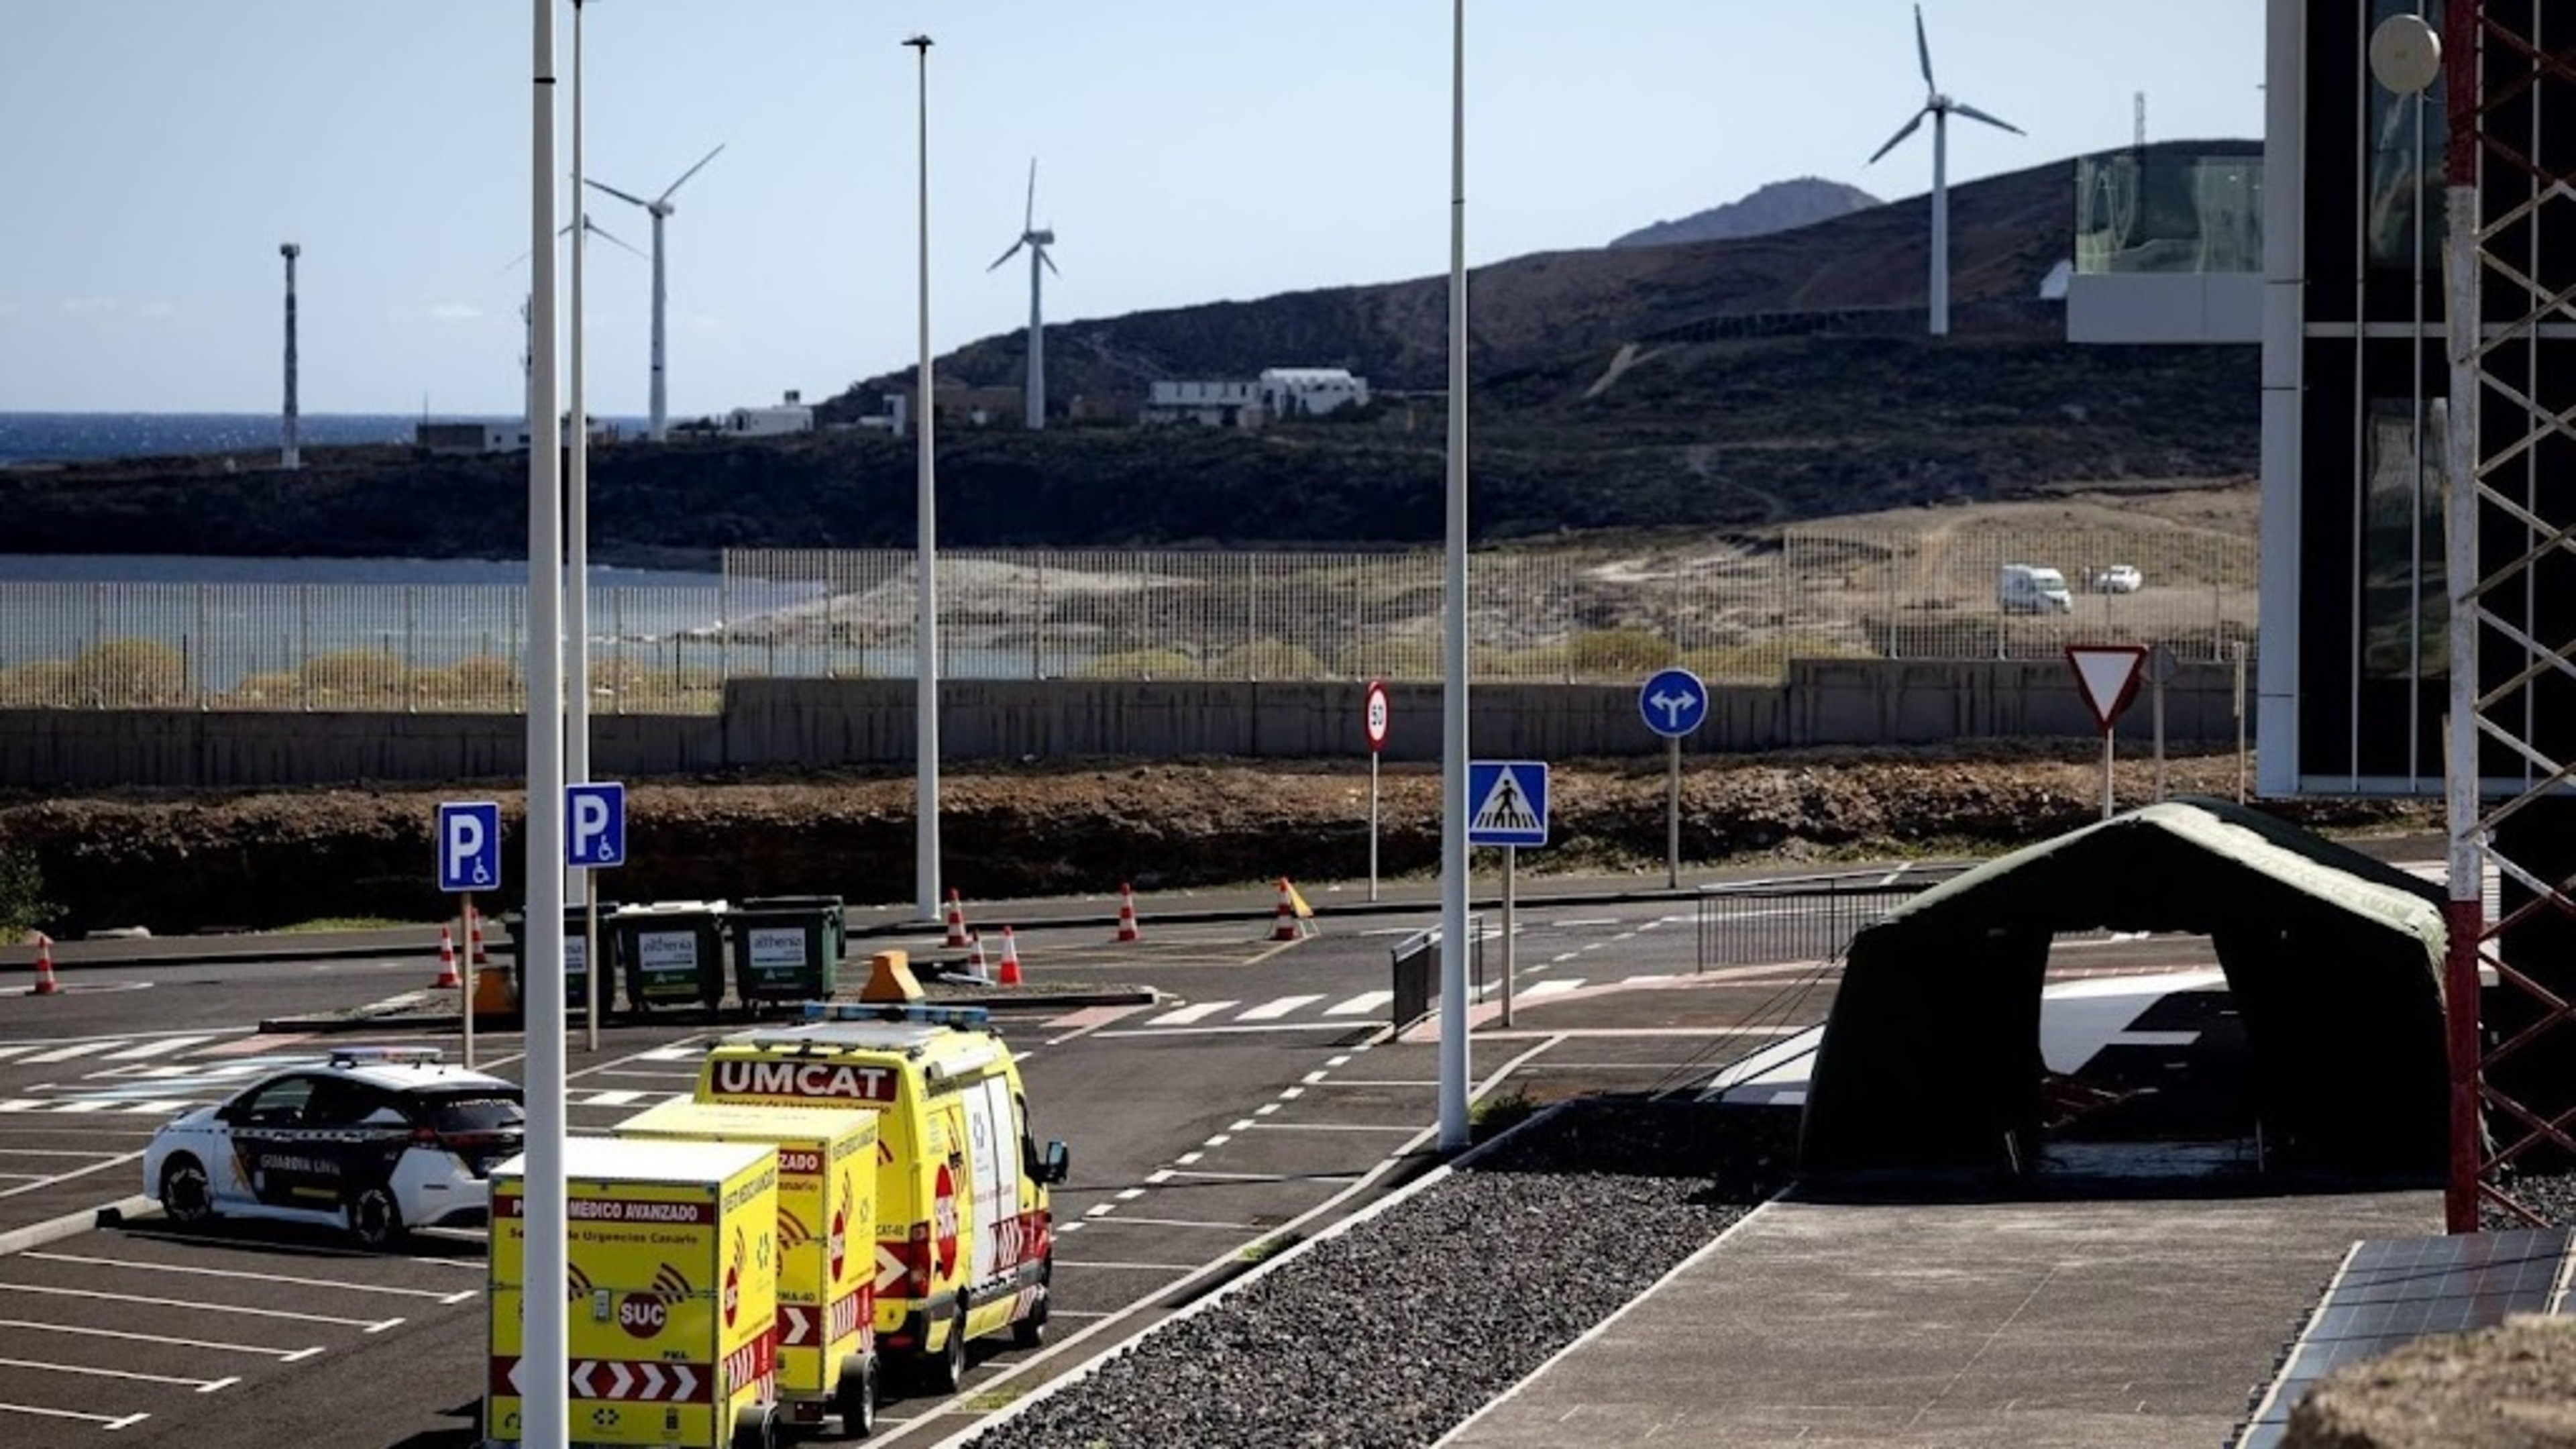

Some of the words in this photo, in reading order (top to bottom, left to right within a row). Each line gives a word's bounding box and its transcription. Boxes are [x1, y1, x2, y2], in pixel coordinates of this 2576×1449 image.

[574, 794, 609, 857] P
[449, 814, 484, 879] P
[720, 1061, 888, 1098] UMCAT
[778, 1154, 818, 1171] ZADO
[625, 1203, 698, 1221] AVANZADO
[620, 1303, 665, 1326] SUC
